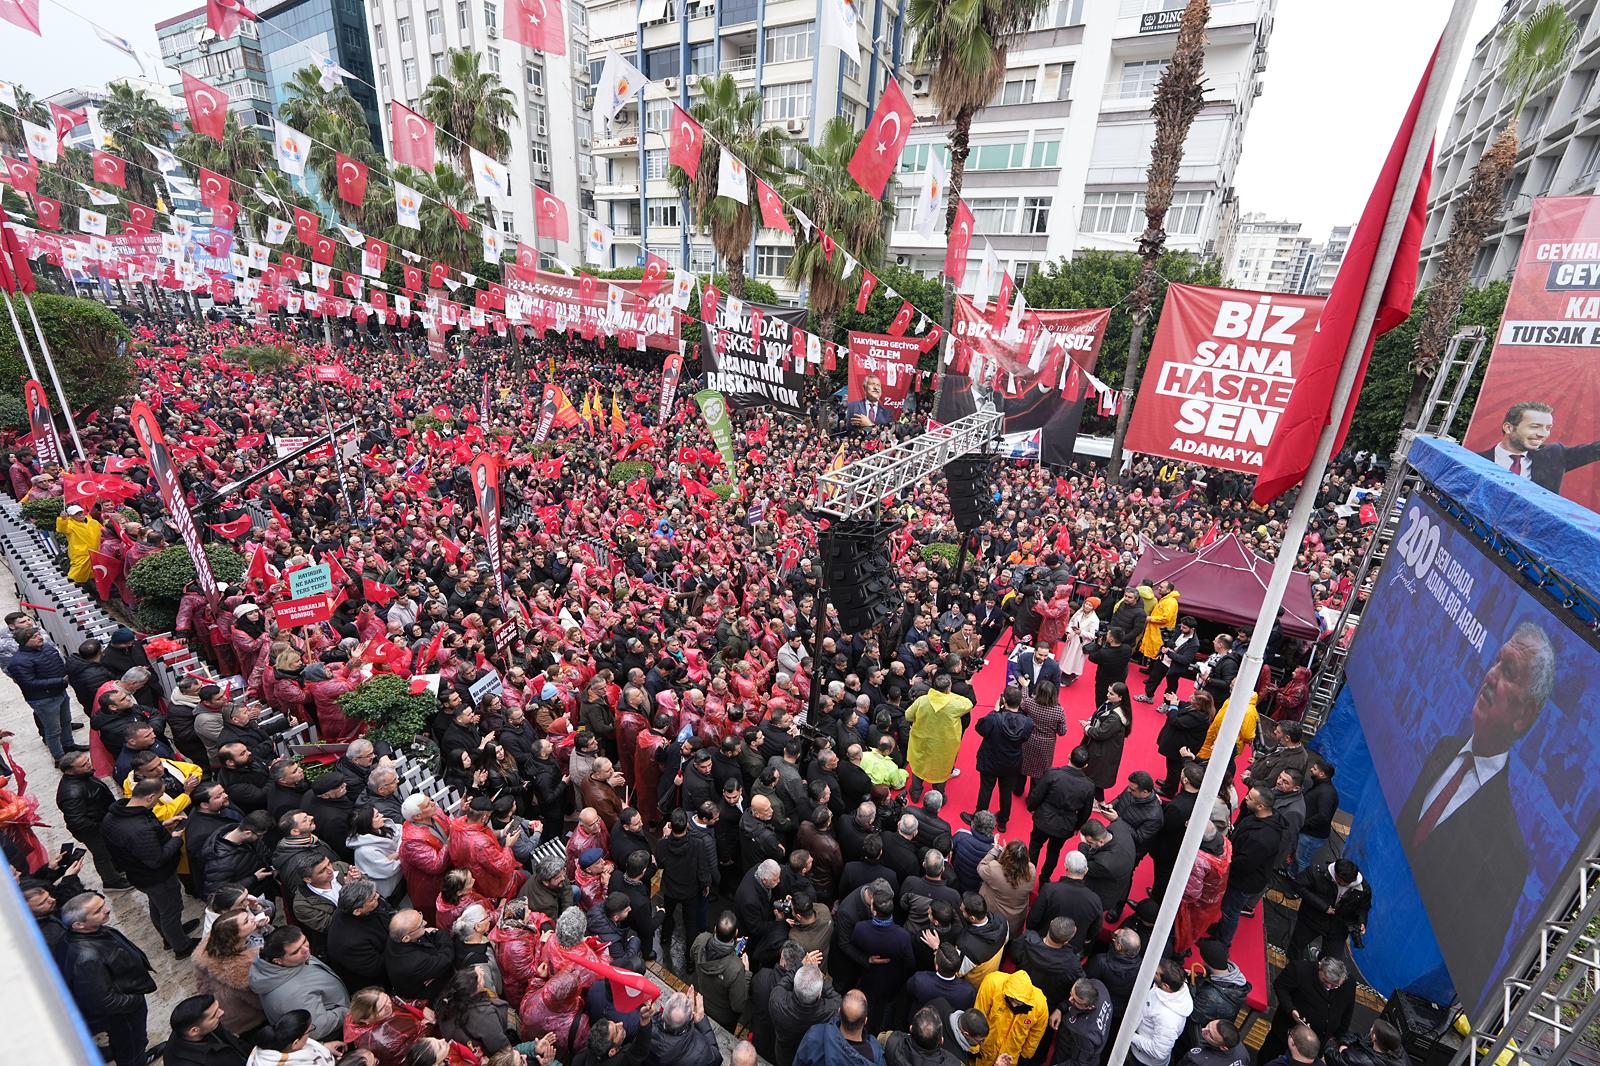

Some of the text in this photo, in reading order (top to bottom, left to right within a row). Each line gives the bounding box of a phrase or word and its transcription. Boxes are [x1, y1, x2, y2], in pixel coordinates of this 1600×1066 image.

[638, 311, 675, 336] ZO!
[714, 310, 789, 341] ADANADAN
[957, 320, 966, 336] O
[1212, 295, 1306, 345] BİZ
[1511, 325, 1587, 345] TUTSAK
[712, 329, 761, 356] BŞKASI
[852, 336, 920, 351] TAKVİMLER GEÇİYOR
[868, 346, 901, 360] ÖZLEM
[1192, 340, 1293, 378] SANA
[706, 371, 800, 409] BAŞKANI YOK
[1163, 365, 1296, 408] HASRE
[1173, 399, 1280, 447] SEN
[1169, 437, 1264, 467] ADANA'YA
[1396, 505, 1441, 579] 200
[1434, 546, 1475, 604] SEN ORADA,
[1424, 568, 1488, 654] ADANA BİR ARADA
